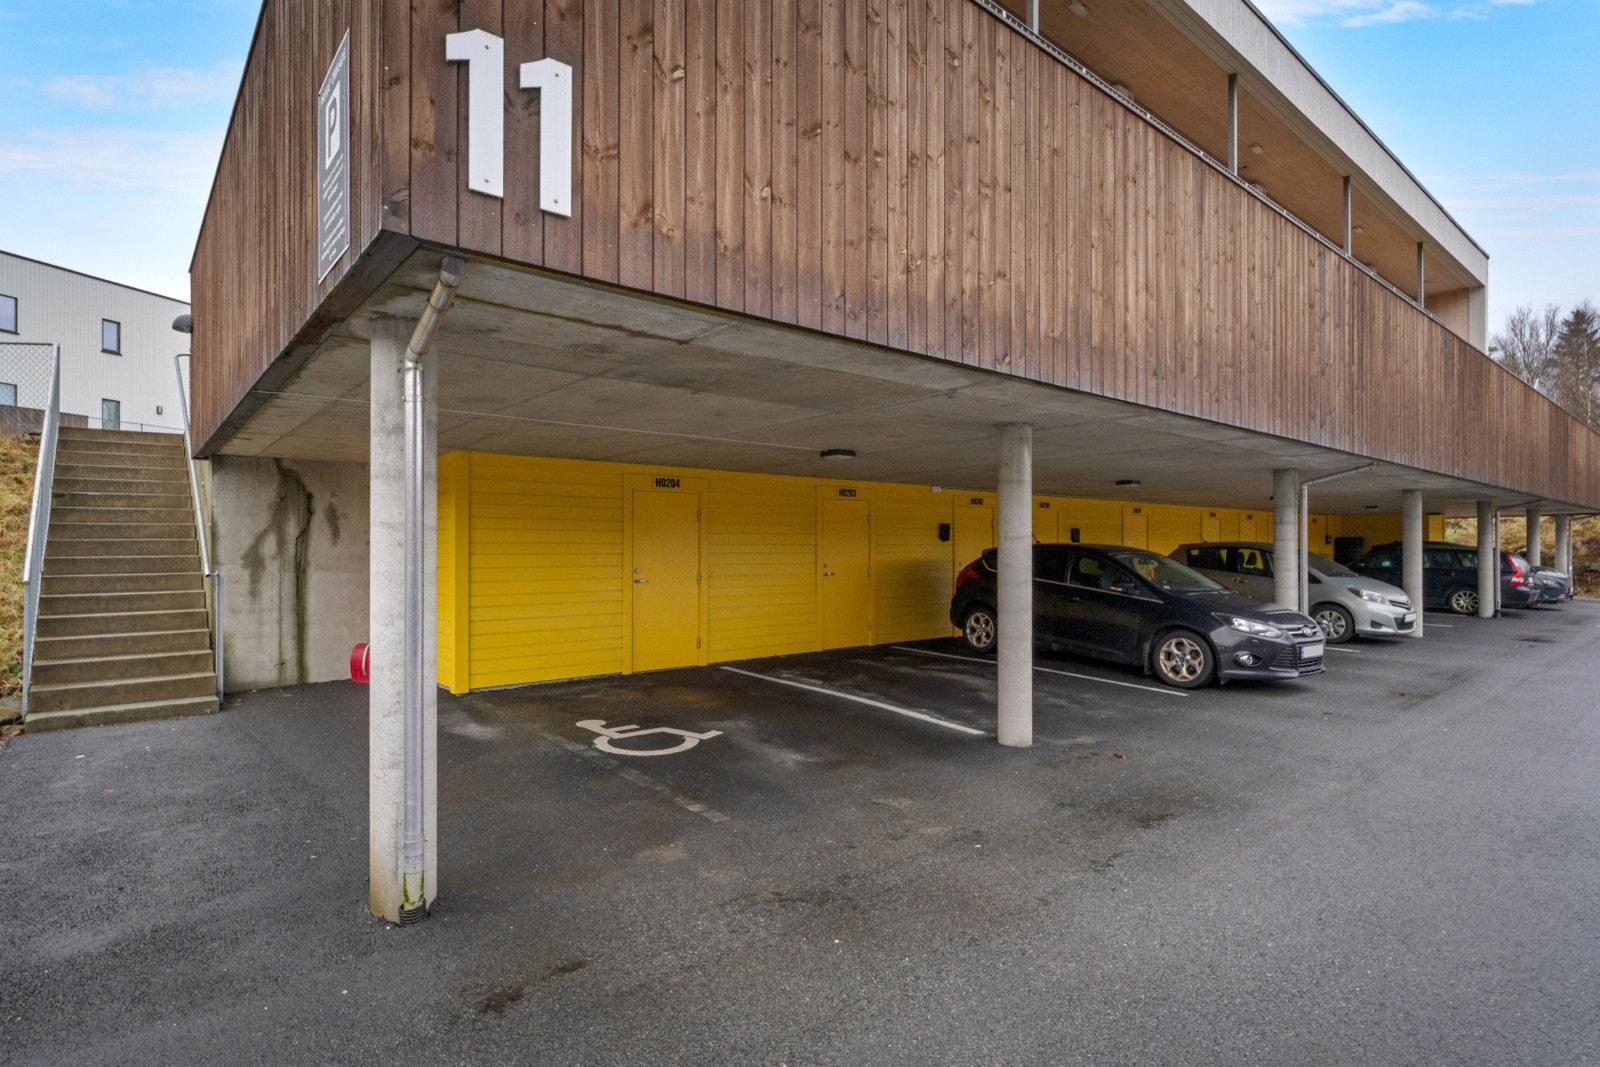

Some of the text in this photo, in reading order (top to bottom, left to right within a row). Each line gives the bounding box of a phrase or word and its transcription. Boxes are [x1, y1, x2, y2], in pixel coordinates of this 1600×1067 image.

[328, 96, 337, 159] P
[446, 28, 573, 217] 11
[655, 477, 680, 488] H0204
